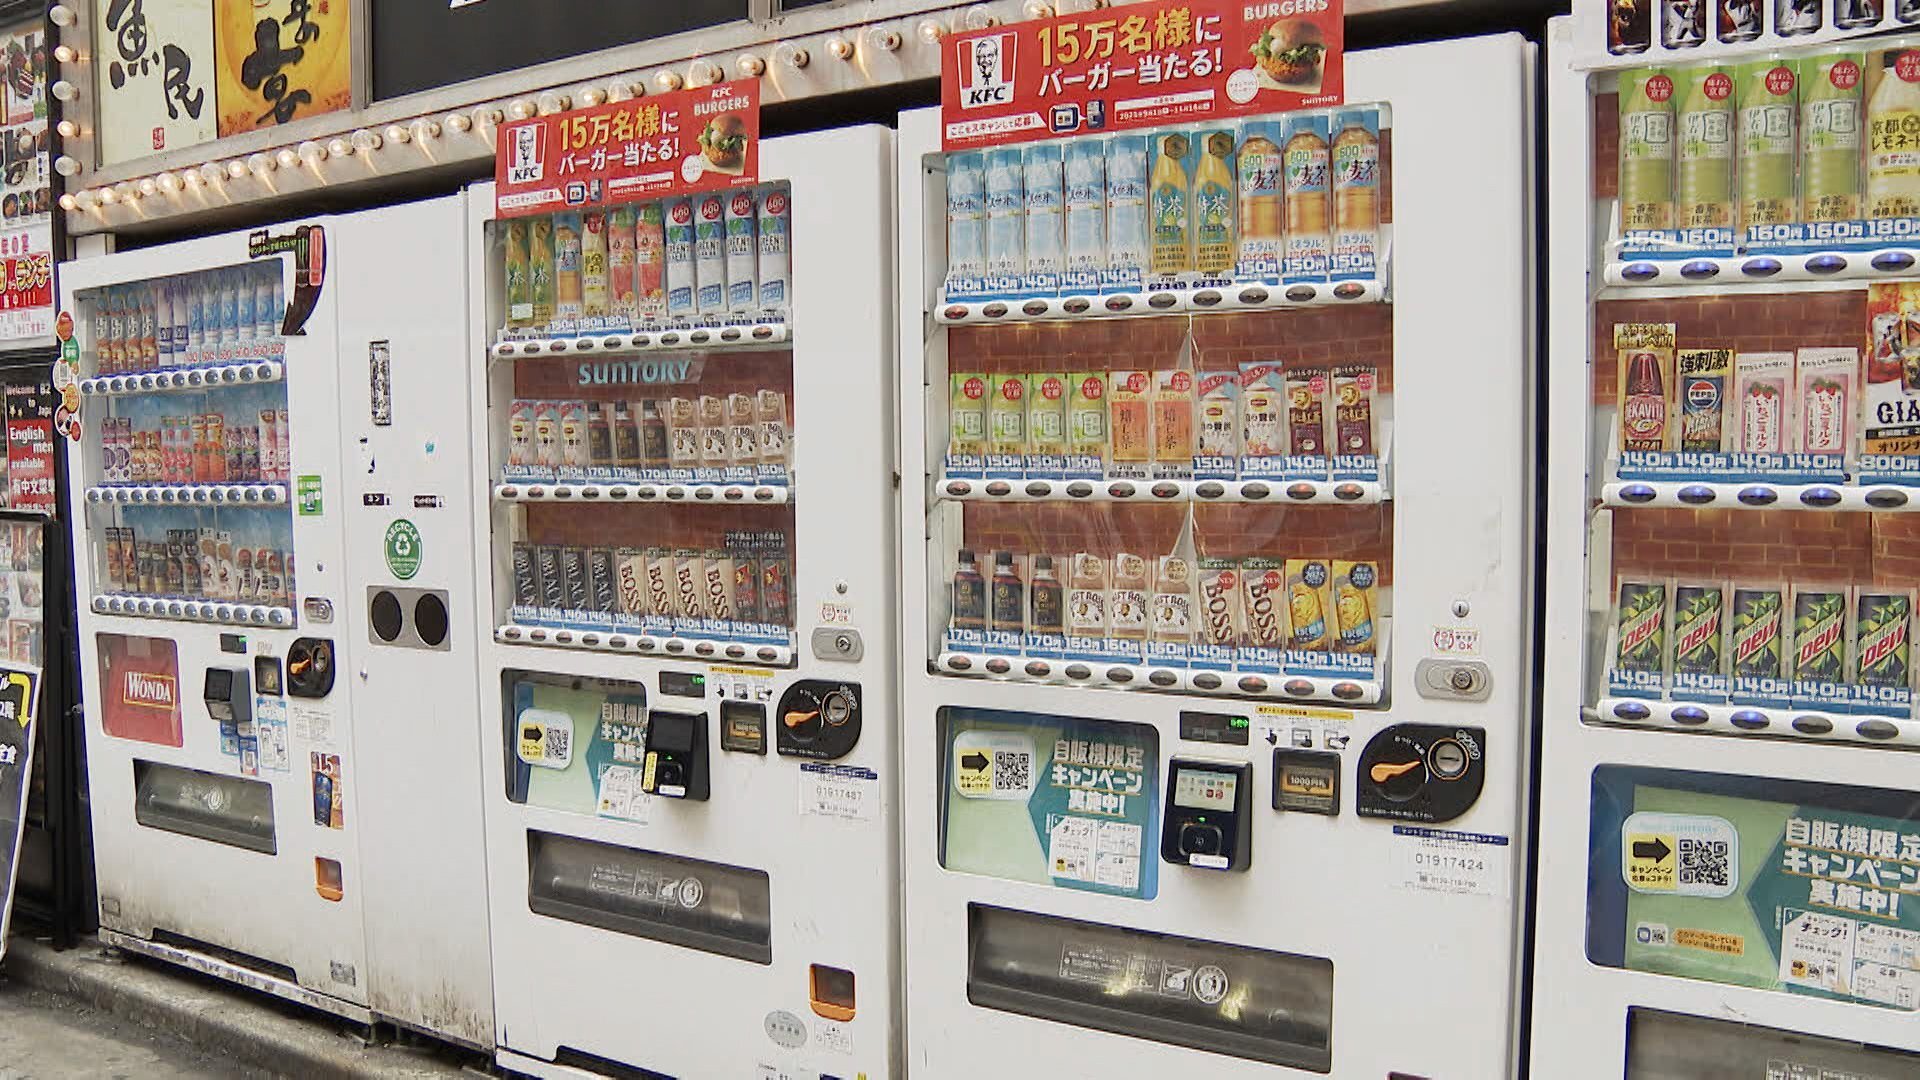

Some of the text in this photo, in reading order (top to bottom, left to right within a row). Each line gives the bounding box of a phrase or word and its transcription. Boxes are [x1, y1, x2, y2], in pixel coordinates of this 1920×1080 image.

[1243, 0, 1329, 20] BURGERS
[1037, 6, 1222, 68] 15万名様に
[1037, 46, 1224, 97] バーガー当たる!
[711, 86, 733, 99] KFC
[969, 86, 1006, 104] KFC
[693, 95, 751, 116] BURGERS
[558, 103, 680, 152] 15万名様に
[1872, 119, 1899, 135] 京都
[558, 137, 681, 176] バーガー当たる!
[513, 166, 538, 181] KFC
[1679, 229, 1733, 244] 160円
[1749, 225, 1803, 241] 160円
[1807, 223, 1863, 238] 160円
[1235, 261, 1278, 274] 150円
[1283, 256, 1326, 272] 150円
[1331, 252, 1375, 268] 150円
[948, 278, 982, 292] 140円
[984, 277, 1018, 291] 140円
[1020, 275, 1056, 289] 140円
[1061, 271, 1099, 287] 140円
[1102, 269, 1139, 285] 140円
[1680, 349, 1730, 375] 強刺激
[578, 360, 692, 386] SUNTORY
[10, 426, 45, 443] English
[1194, 456, 1234, 468] 150円
[1242, 457, 1281, 470] 150円
[1285, 456, 1327, 468] 140円
[1333, 455, 1376, 468] 140円
[1622, 453, 1673, 469] 140円
[1675, 453, 1726, 469] 140円
[1731, 453, 1785, 469] 140円
[1788, 453, 1842, 469] 140円
[386, 521, 420, 542] RECYCLE
[620, 565, 641, 613] BOSS
[649, 565, 669, 615] BOSS
[678, 567, 699, 617] BOSS
[708, 569, 729, 620] BOSS
[1204, 582, 1233, 642] BOSS
[1250, 583, 1279, 643] BOSS
[1191, 644, 1232, 657] 140円
[1238, 647, 1280, 661] 140円
[1287, 650, 1328, 664] 140円
[1331, 652, 1374, 667] 140円
[1611, 670, 1662, 686] 140円
[1675, 673, 1727, 689] 140円
[1736, 677, 1789, 694] 140円
[127, 671, 171, 702] WONDA
[1794, 681, 1849, 697] 140円
[1853, 685, 1909, 702] 140円
[1054, 740, 1145, 769] 自販機限定
[1052, 765, 1143, 794] キャンペーン
[1786, 818, 1920, 864] 自販機限定
[1415, 853, 1484, 870] 01917424
[1631, 865, 1673, 874] キャンペーン
[1783, 847, 1920, 889] キャンペーン
[1809, 879, 1899, 918] 実施中!
[1801, 922, 1848, 940] チェック!
